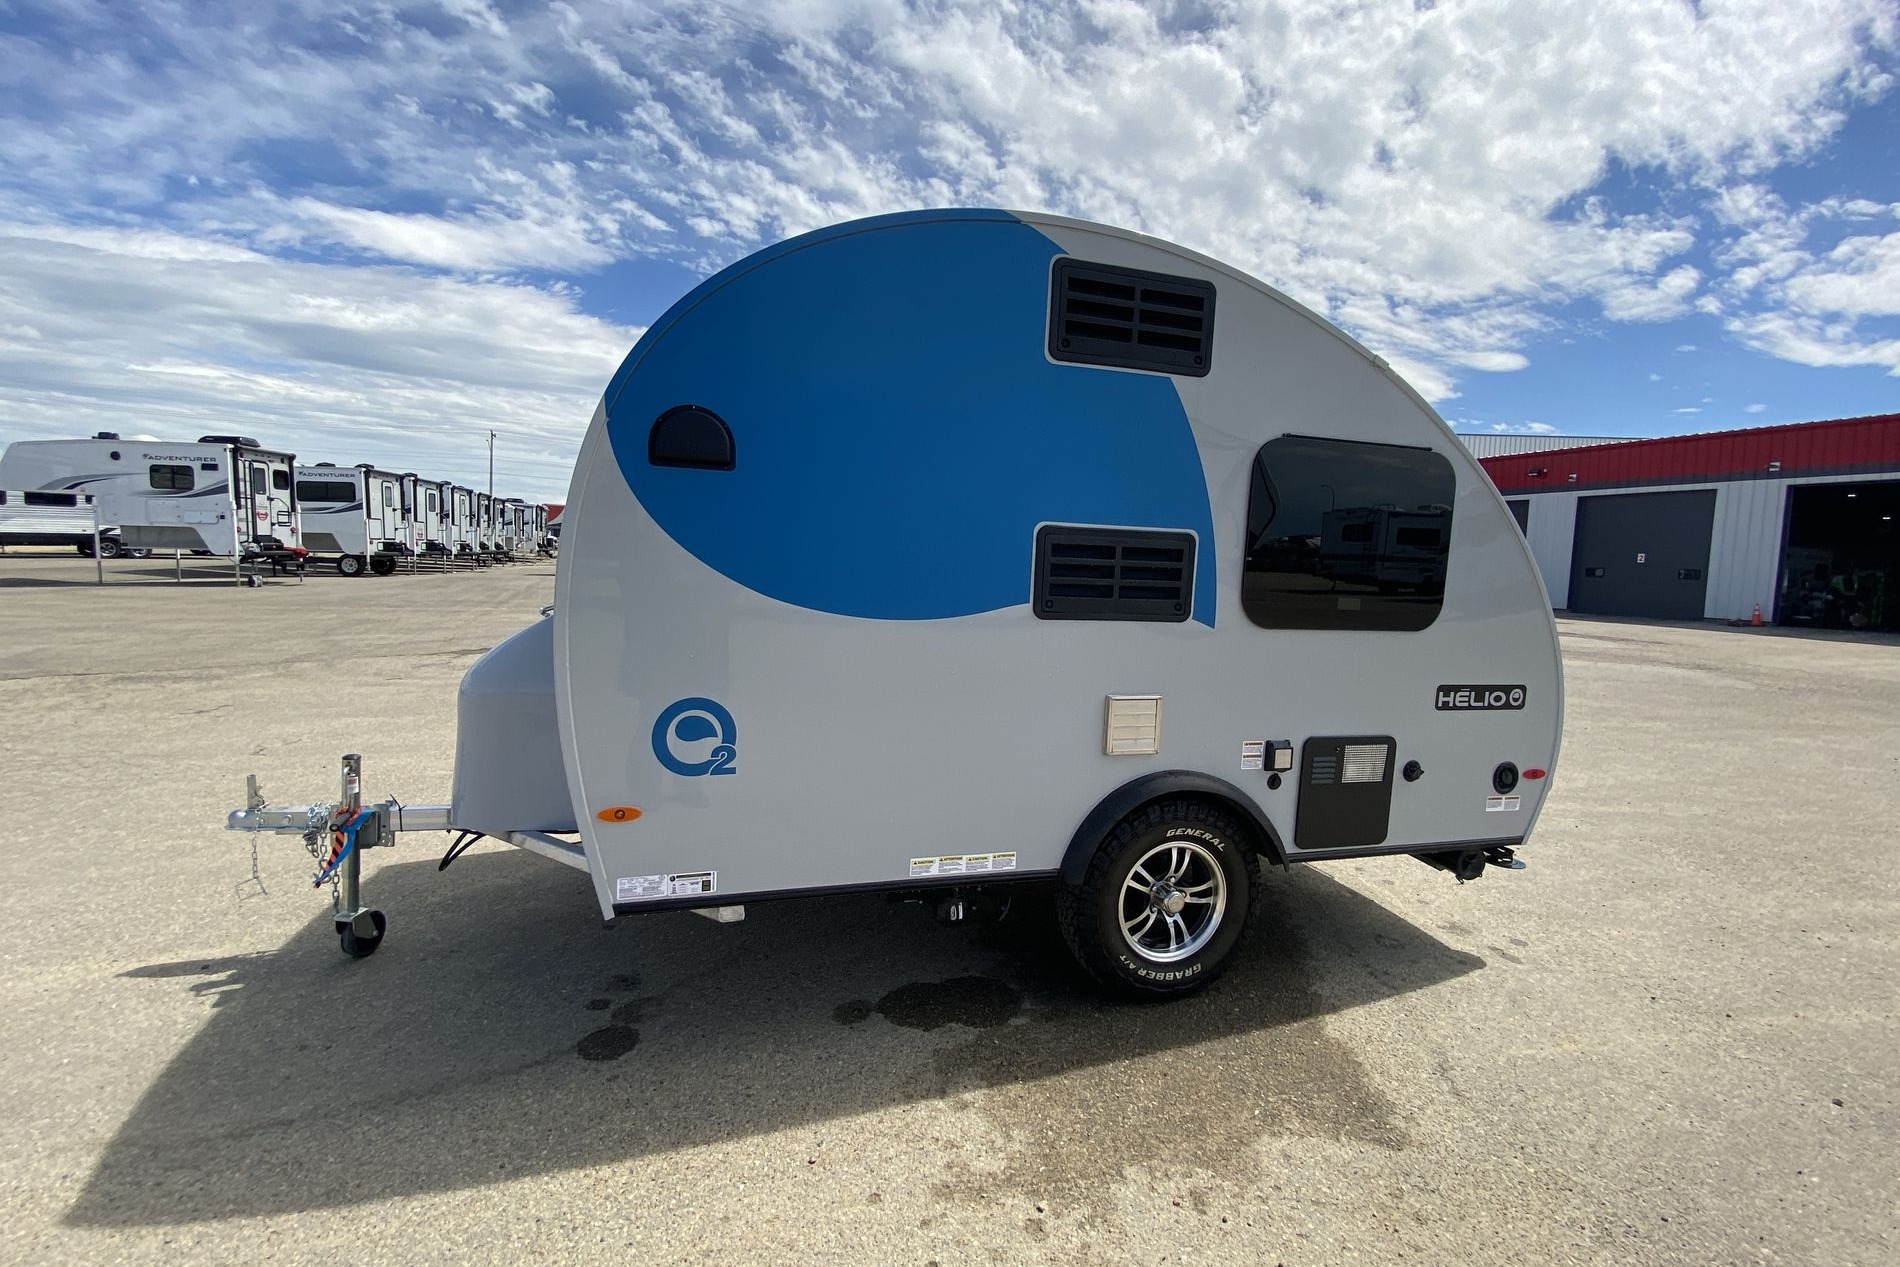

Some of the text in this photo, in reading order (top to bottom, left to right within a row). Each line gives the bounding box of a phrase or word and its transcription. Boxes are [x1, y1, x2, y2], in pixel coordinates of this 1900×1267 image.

[1166, 827, 1225, 852] GENERAL
[1119, 955, 1202, 981] GRABBER A/T
